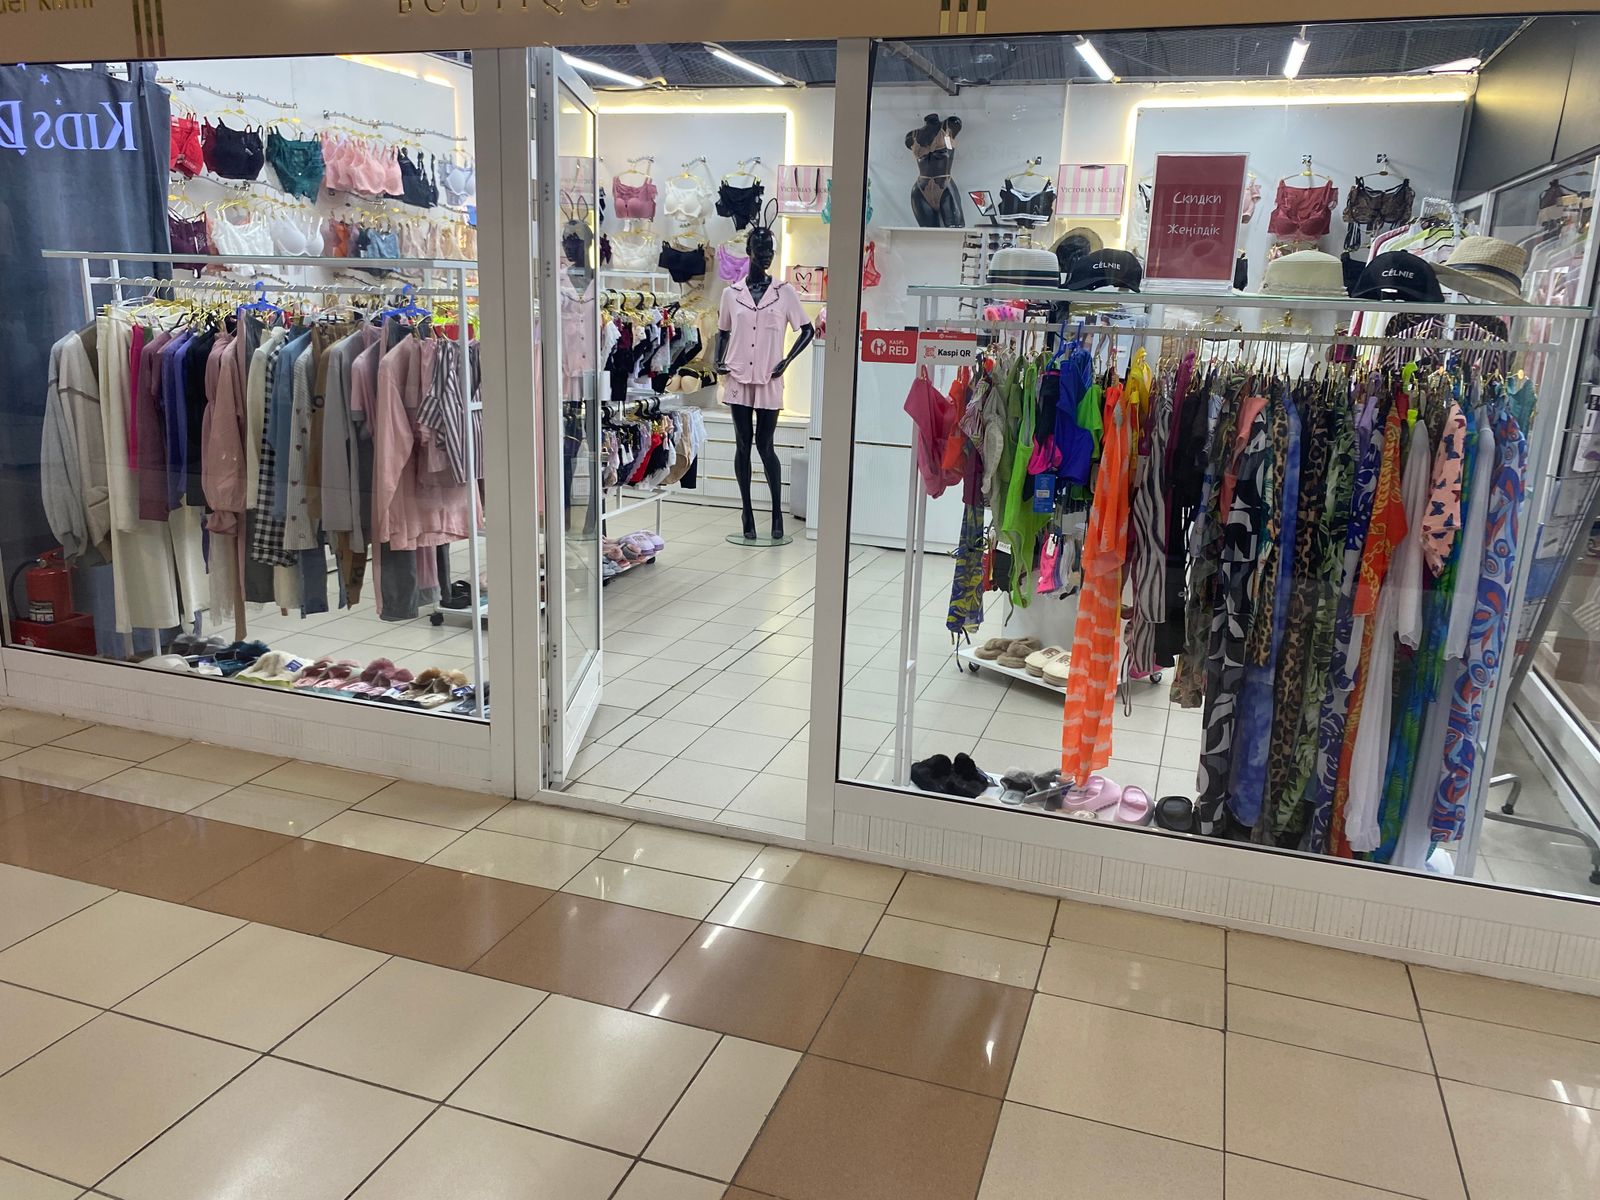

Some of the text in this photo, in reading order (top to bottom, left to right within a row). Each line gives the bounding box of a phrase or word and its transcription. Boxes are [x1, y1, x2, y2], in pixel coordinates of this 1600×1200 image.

[1173, 192, 1222, 206] Скидки
[1167, 223, 1221, 237] Жеңілдік
[1092, 260, 1121, 270] CÉLNIE
[1381, 267, 1415, 279] CÉLNIE
[888, 346, 909, 356] RED
[937, 348, 971, 357] Kaspi QR
